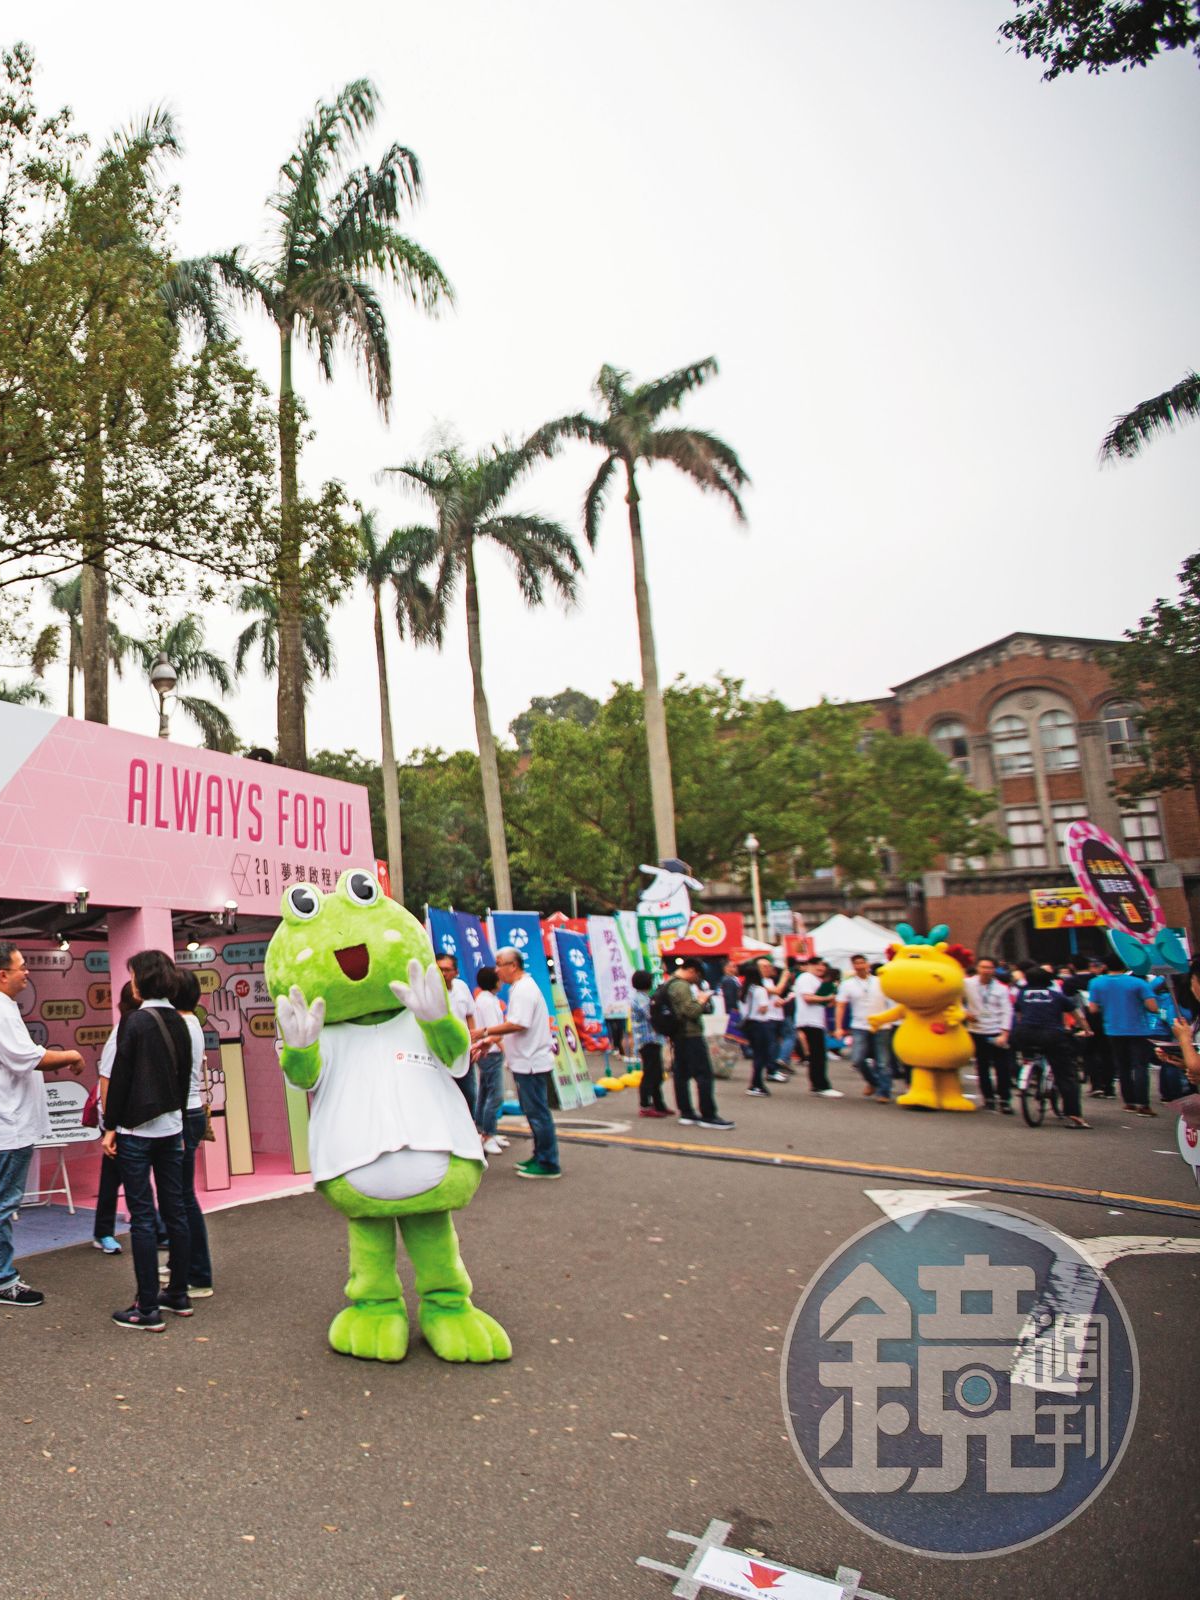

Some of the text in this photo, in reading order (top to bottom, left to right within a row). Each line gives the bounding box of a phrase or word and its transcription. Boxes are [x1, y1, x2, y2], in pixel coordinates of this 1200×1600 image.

[127, 758, 353, 856] ALWAYS FOR U
